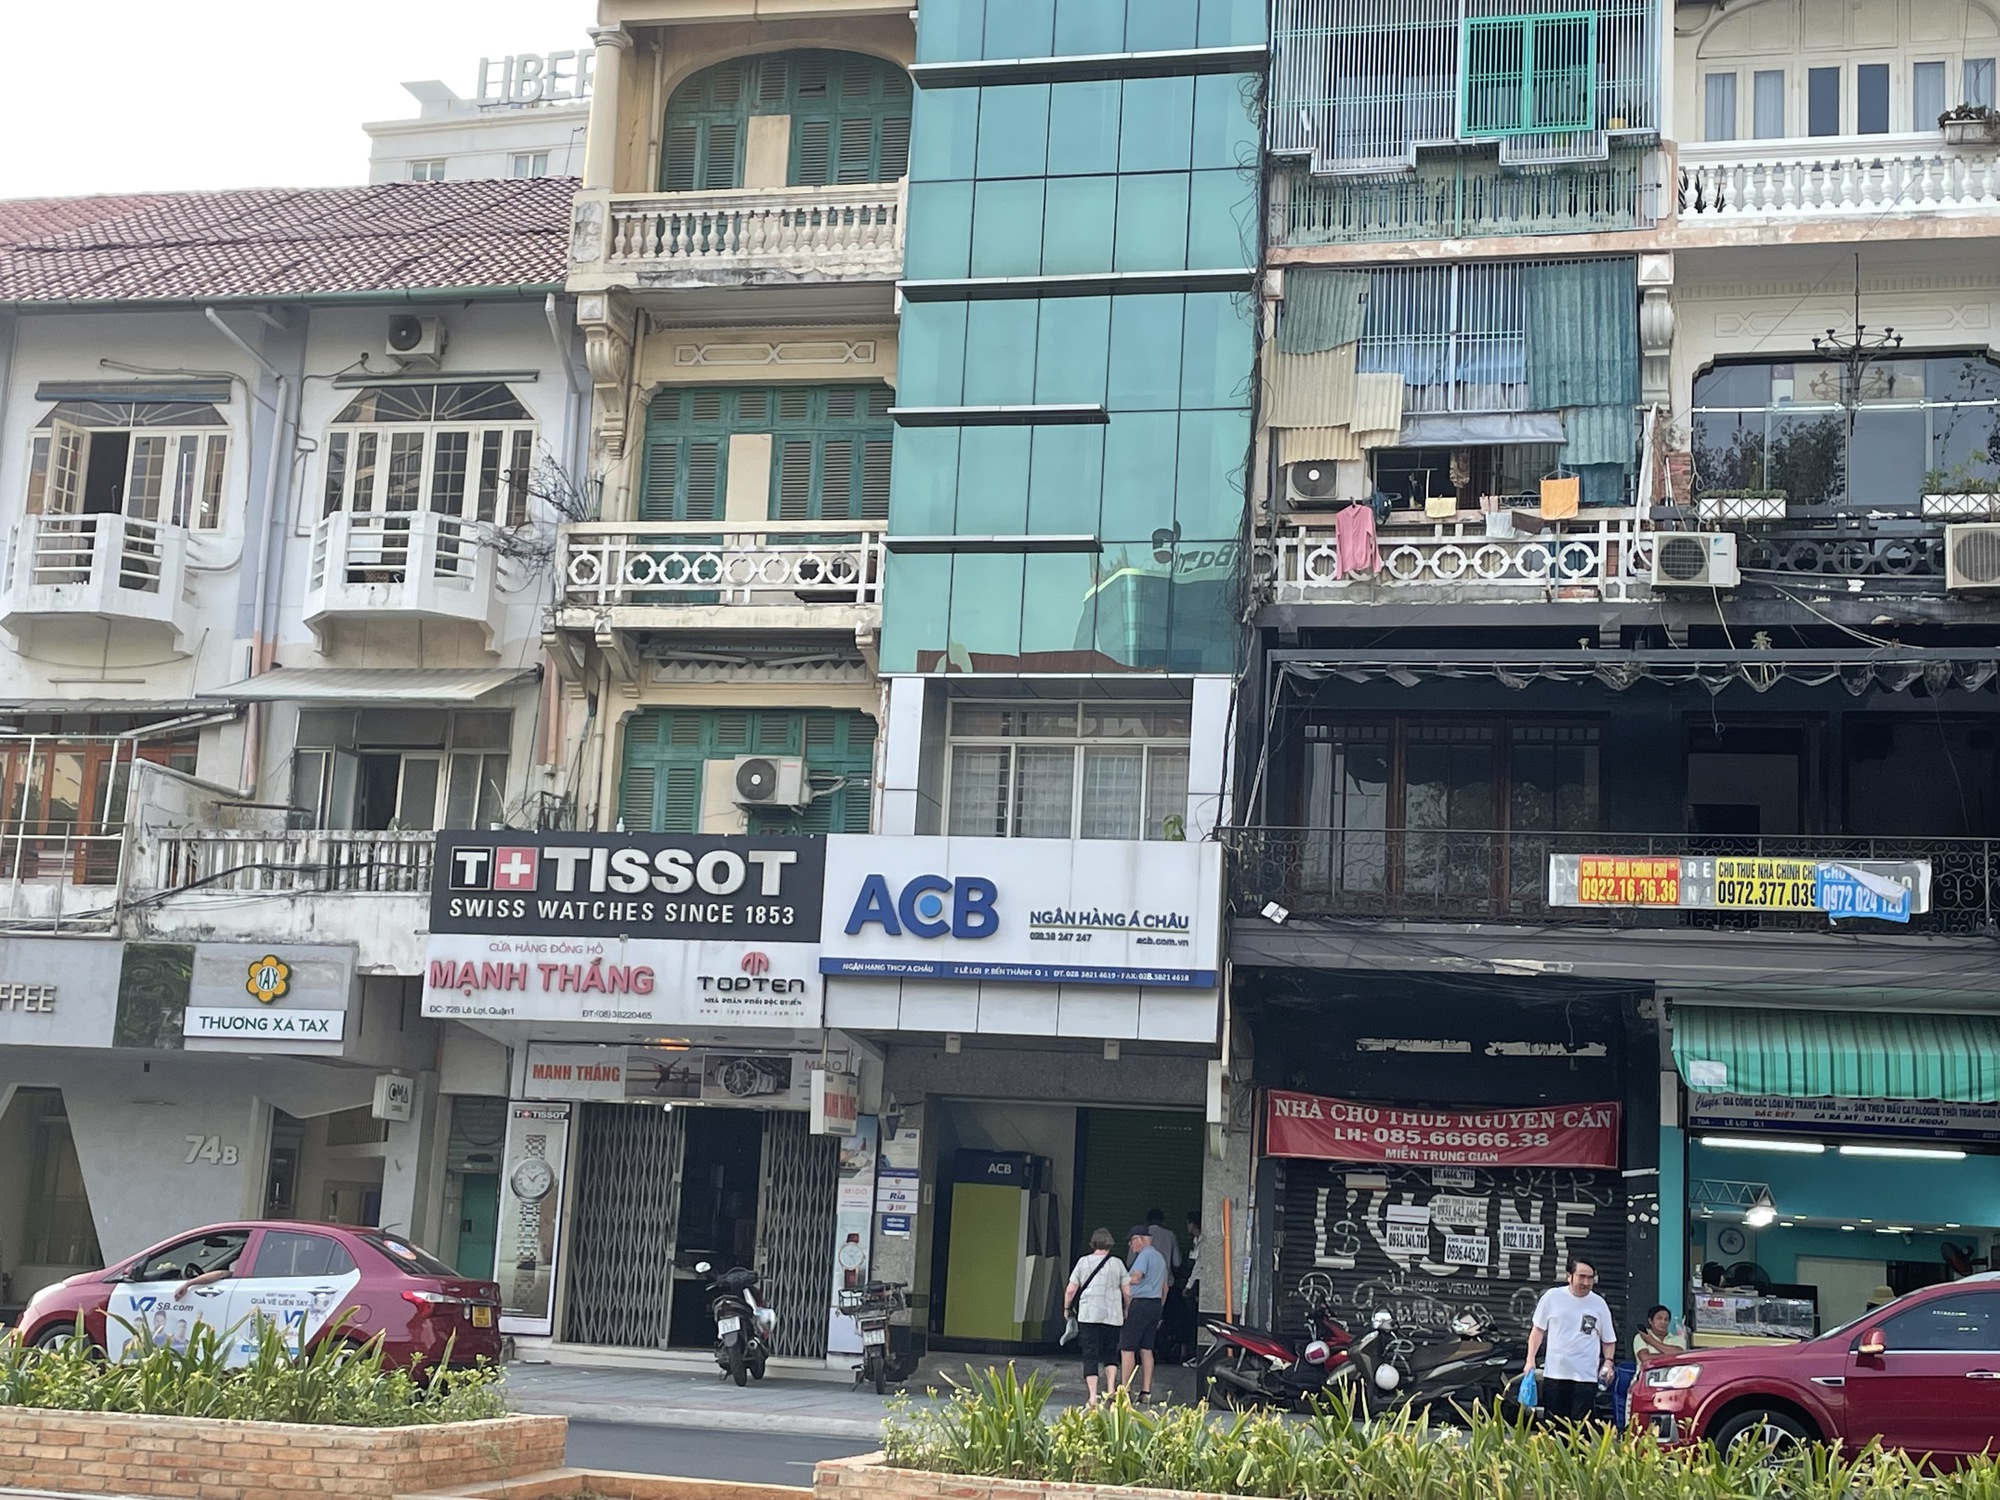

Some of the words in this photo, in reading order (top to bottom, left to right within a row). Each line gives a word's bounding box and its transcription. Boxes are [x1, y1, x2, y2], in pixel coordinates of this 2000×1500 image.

[543, 846, 798, 896] TISSOT
[1718, 861, 1735, 879] CHO
[1736, 860, 1755, 880] THUÊ
[1757, 859, 1774, 880] NHÀ
[1776, 860, 1800, 881] CHÍNH
[843, 873, 1001, 940] ACB
[1822, 883, 1853, 911] 0972
[1855, 885, 1878, 913] 024
[449, 898, 526, 919] SWISS
[537, 899, 654, 923] WATCHES
[665, 903, 734, 924] SINCE
[745, 905, 795, 926] 1853
[1029, 907, 1076, 925] NGÂN
[1079, 907, 1127, 927] HÀNG
[1128, 910, 1141, 927] Á
[1143, 911, 1189, 929] CHÂU
[515, 942, 547, 953] HÀNG
[1057, 932, 1074, 942] 247
[1075, 933, 1093, 943] 247
[1136, 935, 1189, 947] acb.com.vn
[258, 966, 279, 990] TAX
[430, 960, 528, 997] MẠNH
[538, 957, 655, 996] THẮNG
[199, 1014, 268, 1033] THƯƠNG
[298, 1018, 329, 1033] TAX
[532, 1110, 566, 1120] TISSOT
[1274, 1097, 1323, 1120] NHÀ
[1330, 1104, 1379, 1125] CHO
[1334, 1126, 1368, 1143] LH:
[1373, 1127, 1550, 1148] 085.66666.38
[184, 1134, 239, 1166] 74B
[1422, 1148, 1467, 1162] TRUNG
[1467, 1150, 1499, 1162] GIAN
[987, 1163, 1013, 1175] ACB
[844, 1186, 868, 1196] MIDO
[1447, 1282, 1490, 1297] VIETNAM
[156, 1302, 194, 1312] SB.com
